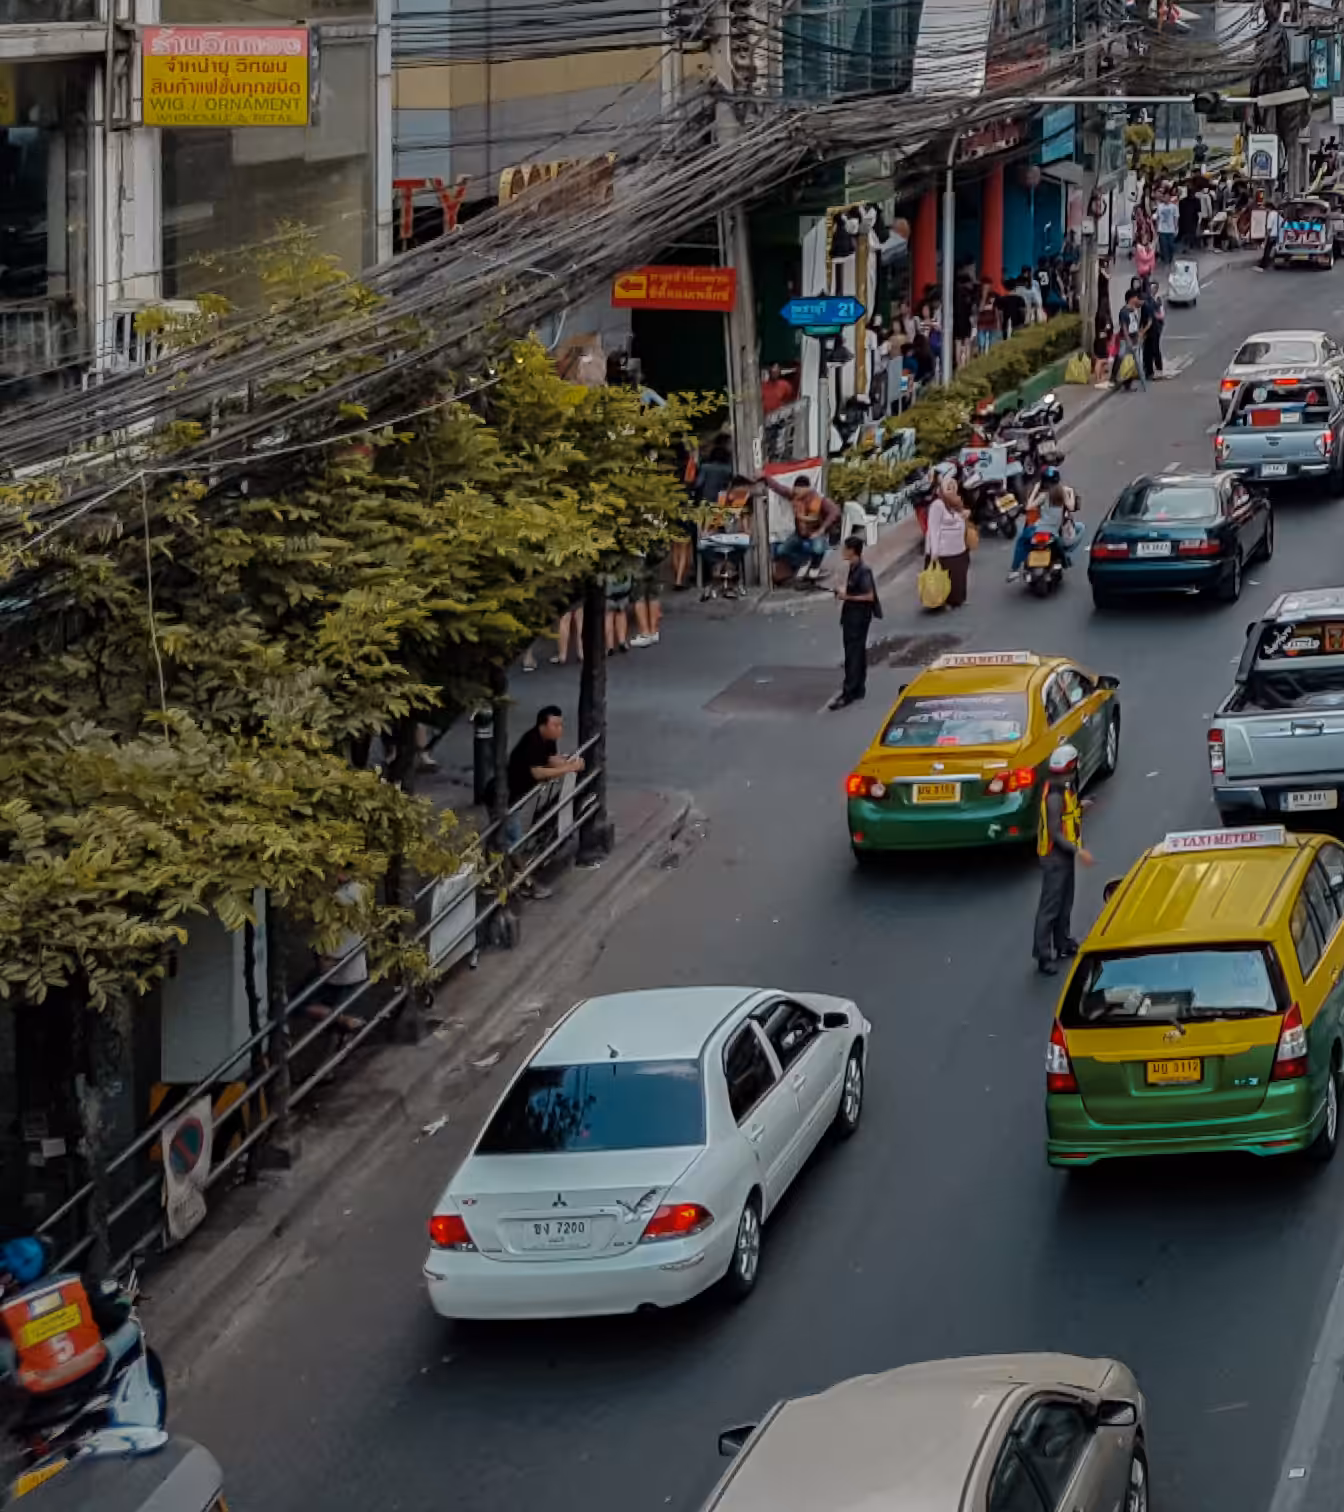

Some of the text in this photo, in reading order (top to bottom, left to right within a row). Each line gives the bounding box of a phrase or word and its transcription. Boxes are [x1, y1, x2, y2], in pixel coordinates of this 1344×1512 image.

[150, 98, 184, 111] WIG
[205, 98, 301, 111] ORNAMENT
[838, 302, 855, 317] 21
[1182, 832, 1258, 847] TAXI METER
[556, 1221, 585, 1234] 7200
[51, 1332, 75, 1363] 5
